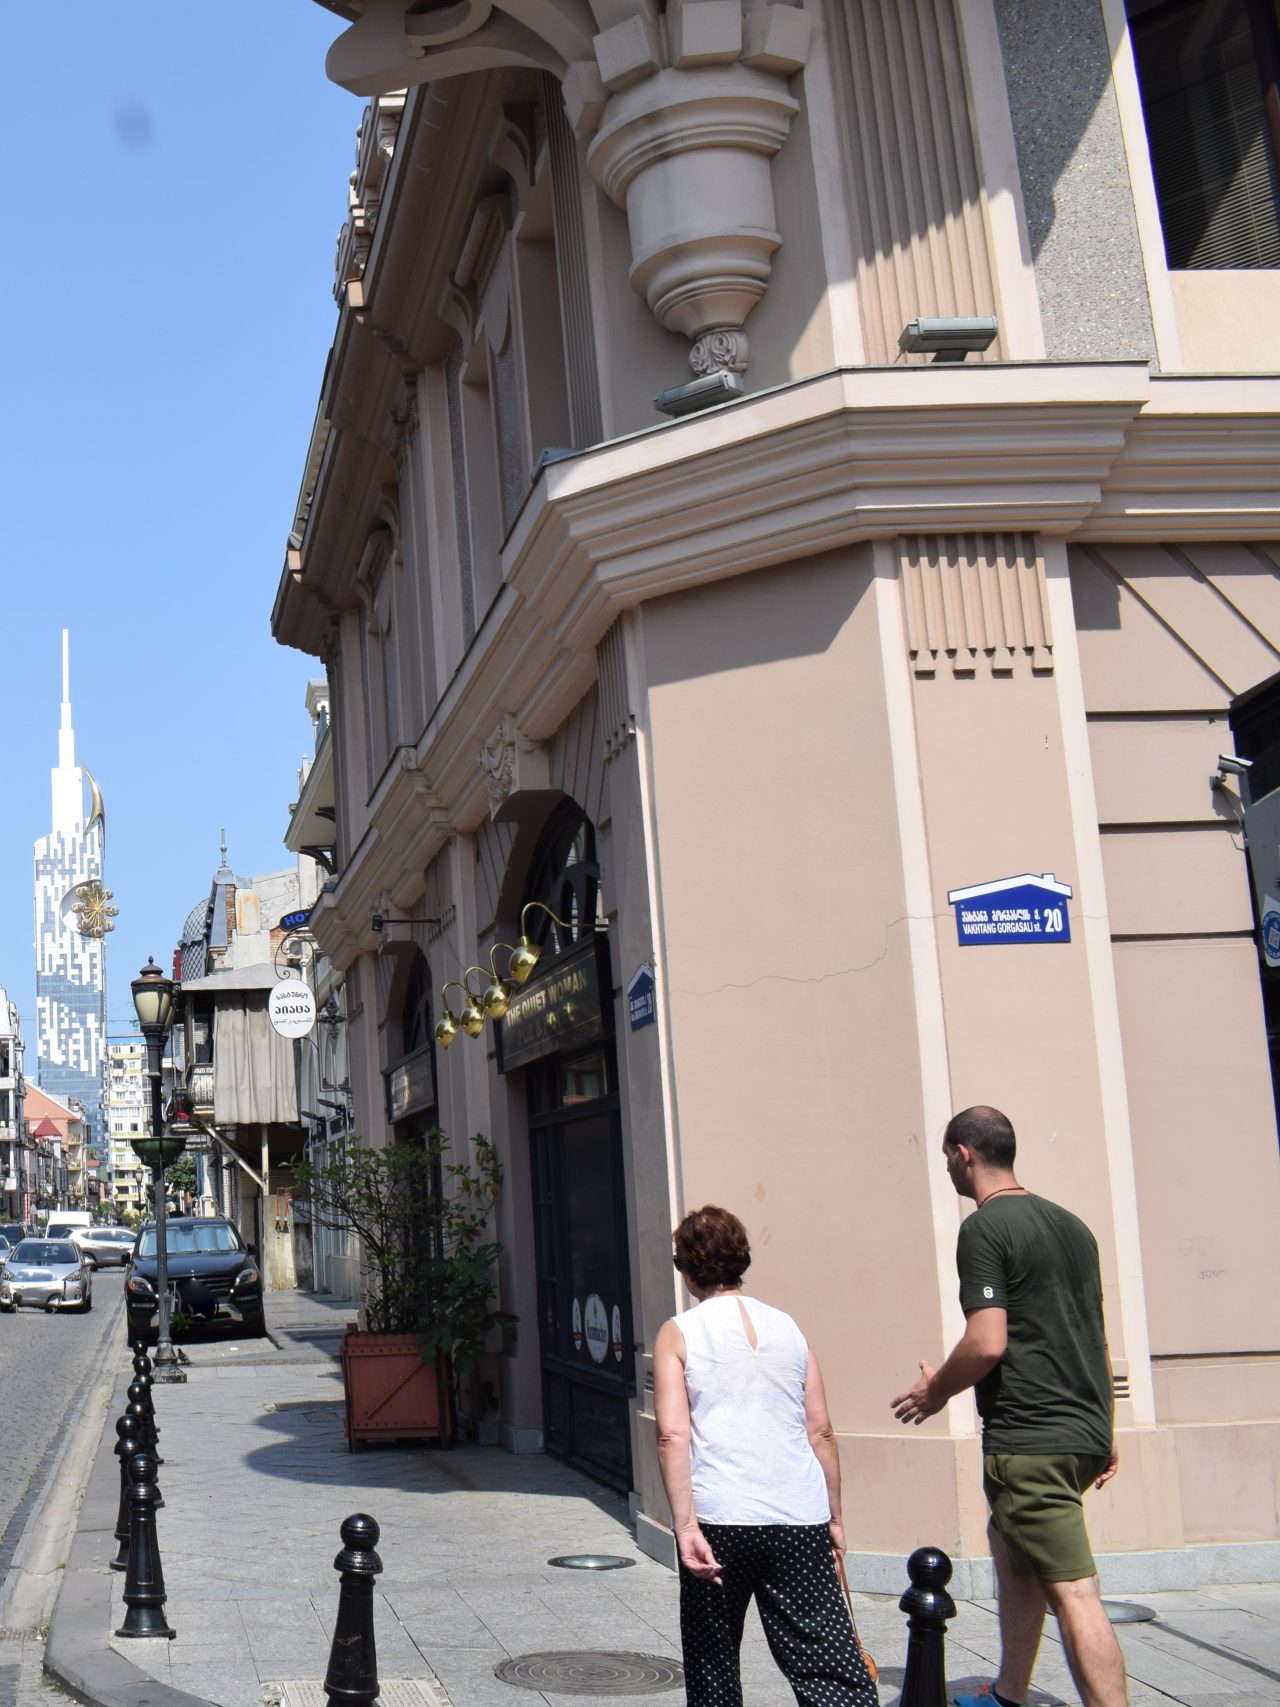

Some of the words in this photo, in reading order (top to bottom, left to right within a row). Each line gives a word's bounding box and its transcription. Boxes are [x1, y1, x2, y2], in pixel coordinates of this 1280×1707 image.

[284, 912, 308, 926] HO
[962, 922, 996, 935] VAKHTANG
[996, 921, 1034, 934] GORGASALI
[1043, 908, 1063, 933] 20
[505, 1004, 521, 1029] THE
[521, 989, 547, 1019] QUIET
[547, 967, 588, 1005] WOMAN
